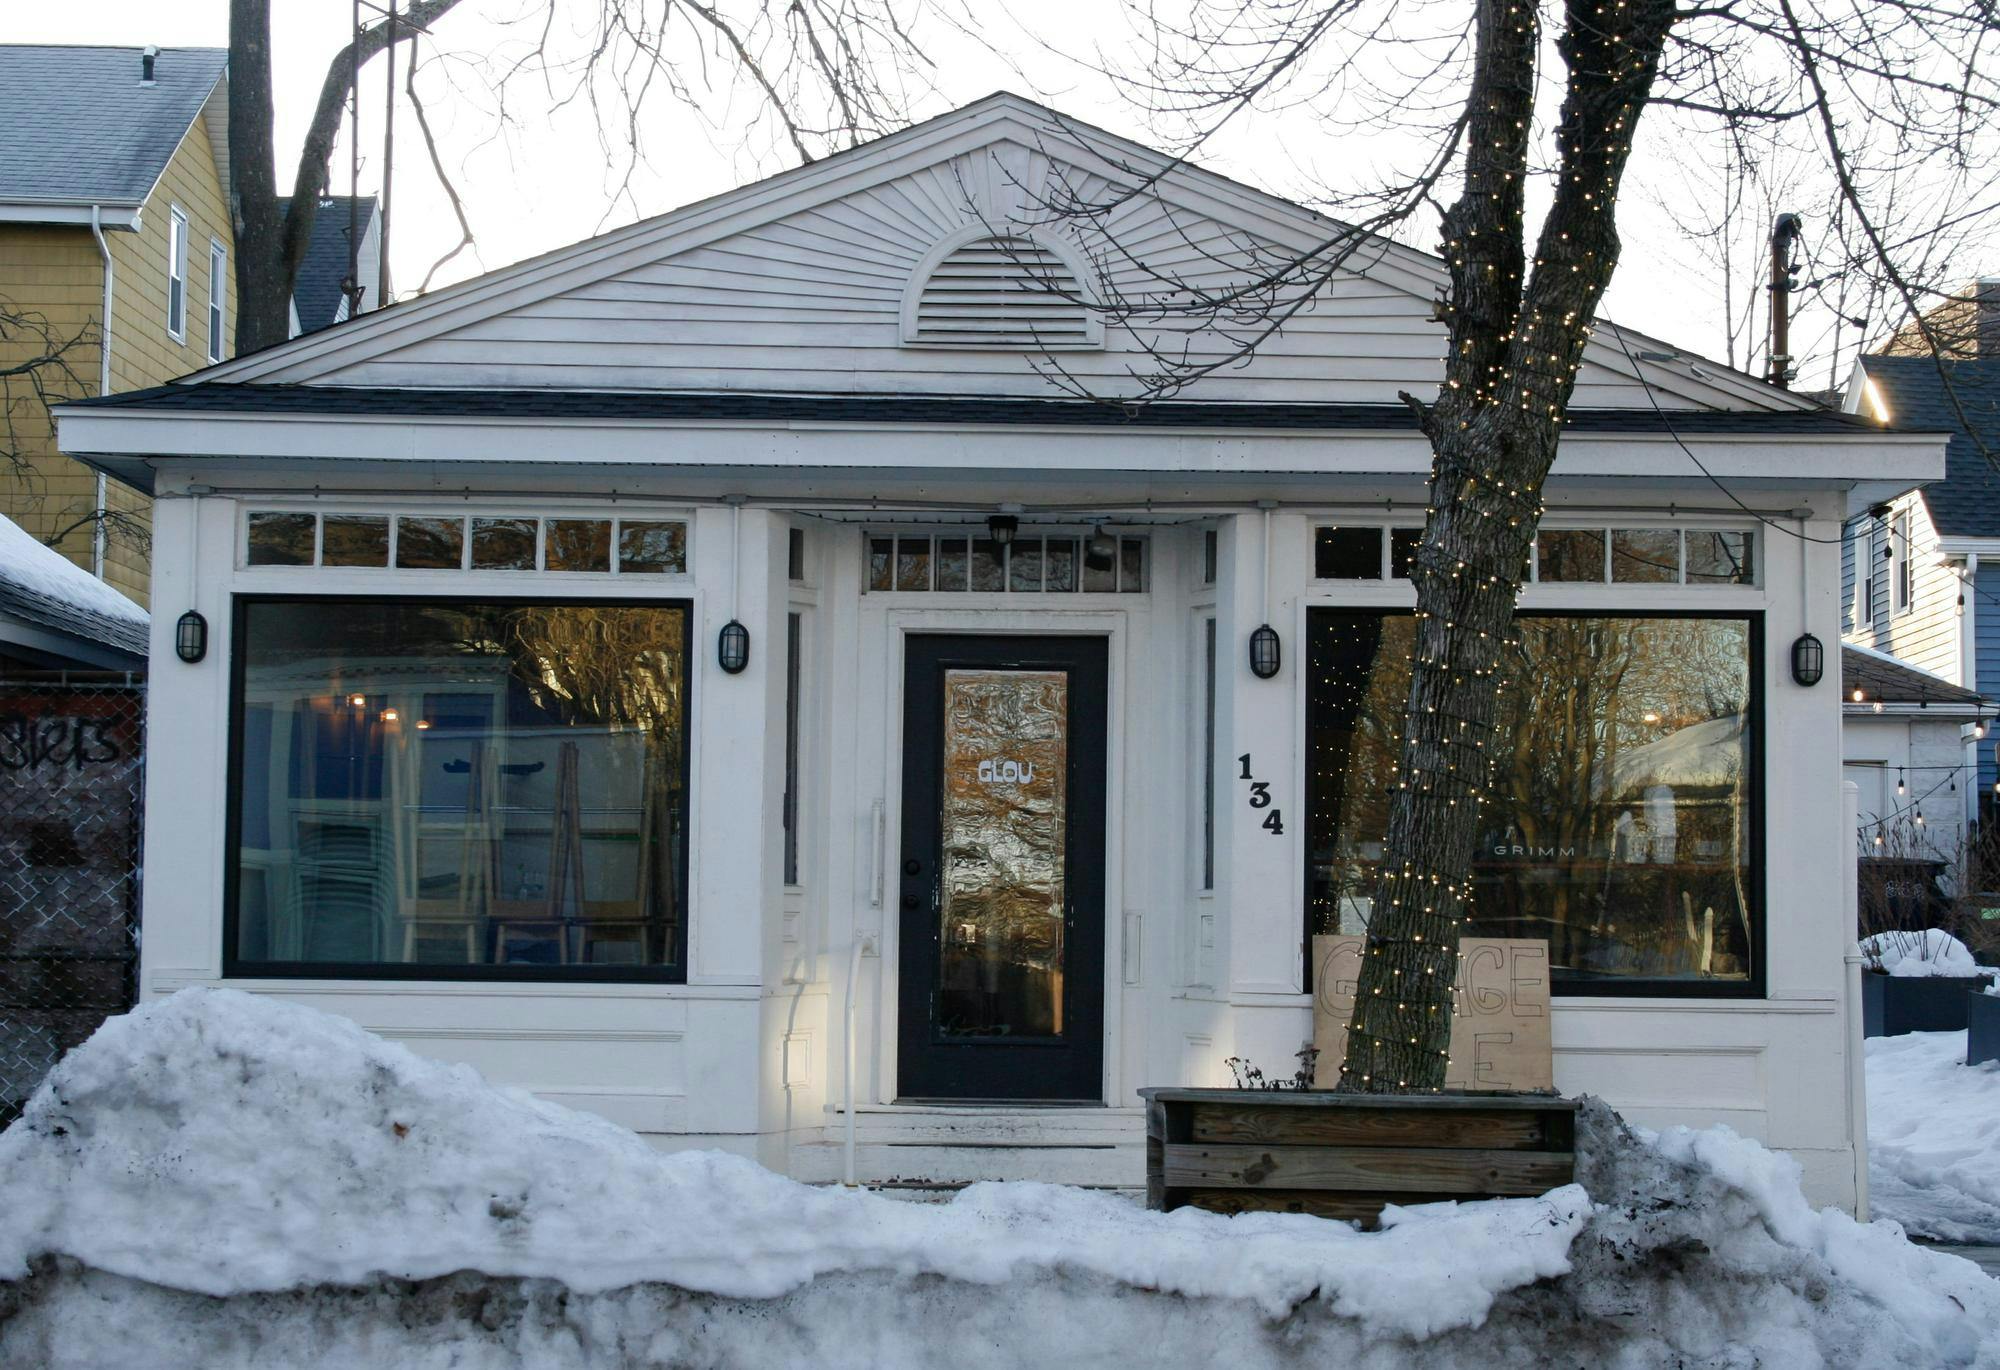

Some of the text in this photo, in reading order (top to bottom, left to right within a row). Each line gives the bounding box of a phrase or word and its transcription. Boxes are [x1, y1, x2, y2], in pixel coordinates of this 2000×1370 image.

[978, 760, 1032, 784] GLOU
[1238, 753, 1284, 835] 134
[1494, 845, 1575, 857] GRIMM
